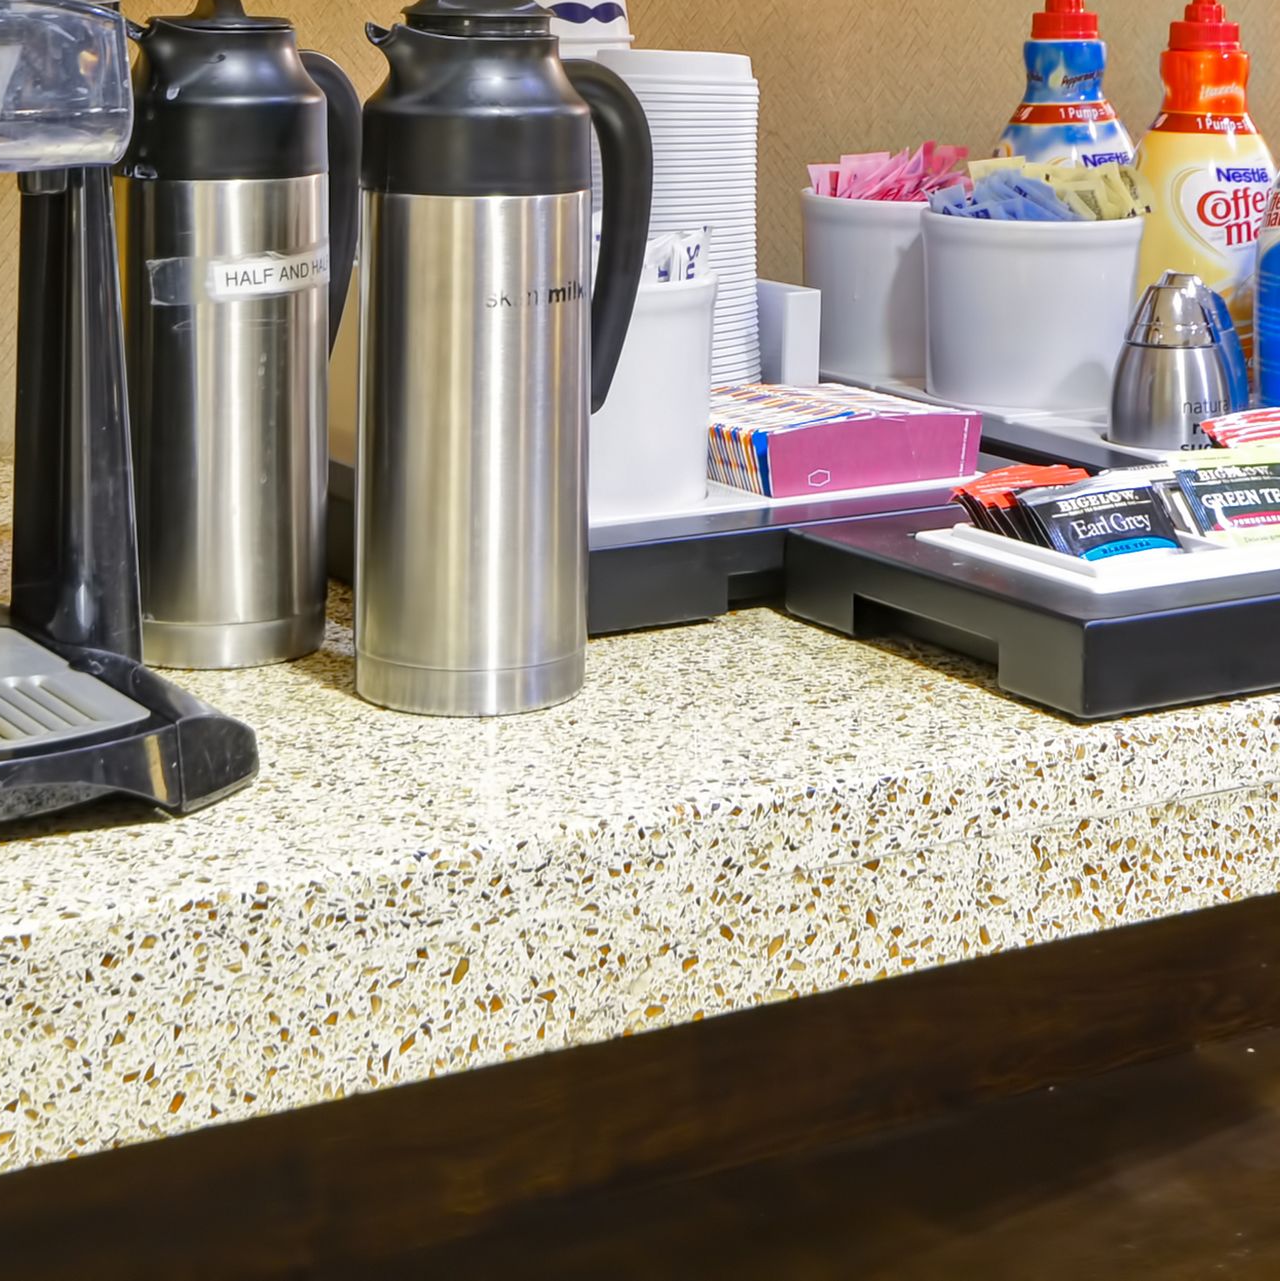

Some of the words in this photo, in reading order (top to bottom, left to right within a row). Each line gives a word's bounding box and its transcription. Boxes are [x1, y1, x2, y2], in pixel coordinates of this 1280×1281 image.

[1059, 107, 1066, 119] 1
[1196, 117, 1203, 130] 1
[1216, 167, 1270, 183] Nestlé
[225, 267, 274, 288] HALF
[279, 262, 309, 282] AND
[312, 255, 328, 276] HAL
[1201, 489, 1262, 509] GREEN
[1071, 516, 1108, 539] Earl
[1108, 513, 1152, 532] Grey
